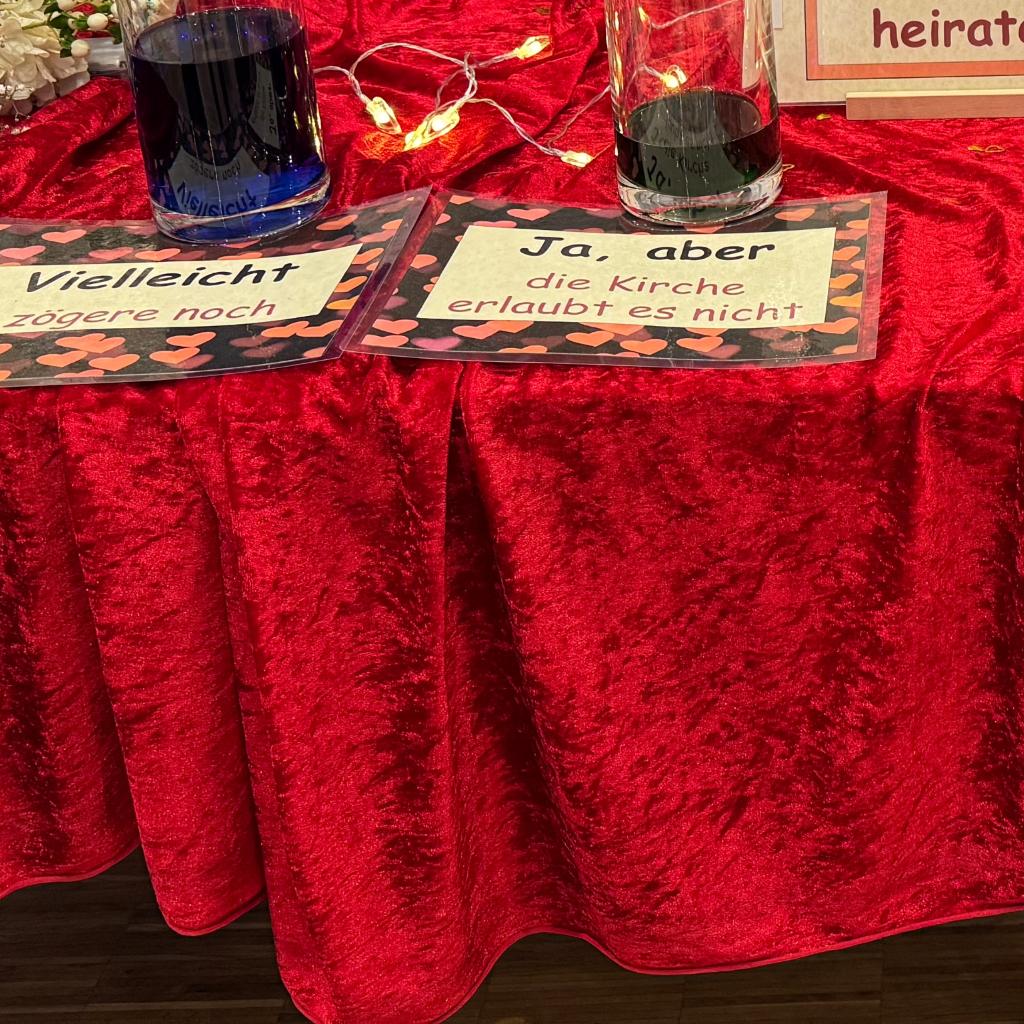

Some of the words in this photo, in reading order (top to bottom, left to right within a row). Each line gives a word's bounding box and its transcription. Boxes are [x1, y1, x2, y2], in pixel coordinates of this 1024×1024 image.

[520, 236, 611, 262] Ja,
[647, 239, 776, 261] aber
[26, 262, 300, 292] Vielleicht
[526, 272, 591, 290] die
[608, 274, 746, 296] Kirche
[2, 308, 159, 330] zögere
[173, 298, 276, 321] noch
[447, 295, 613, 317] erlaubt
[628, 304, 676, 320] es
[692, 301, 803, 322] nicht
